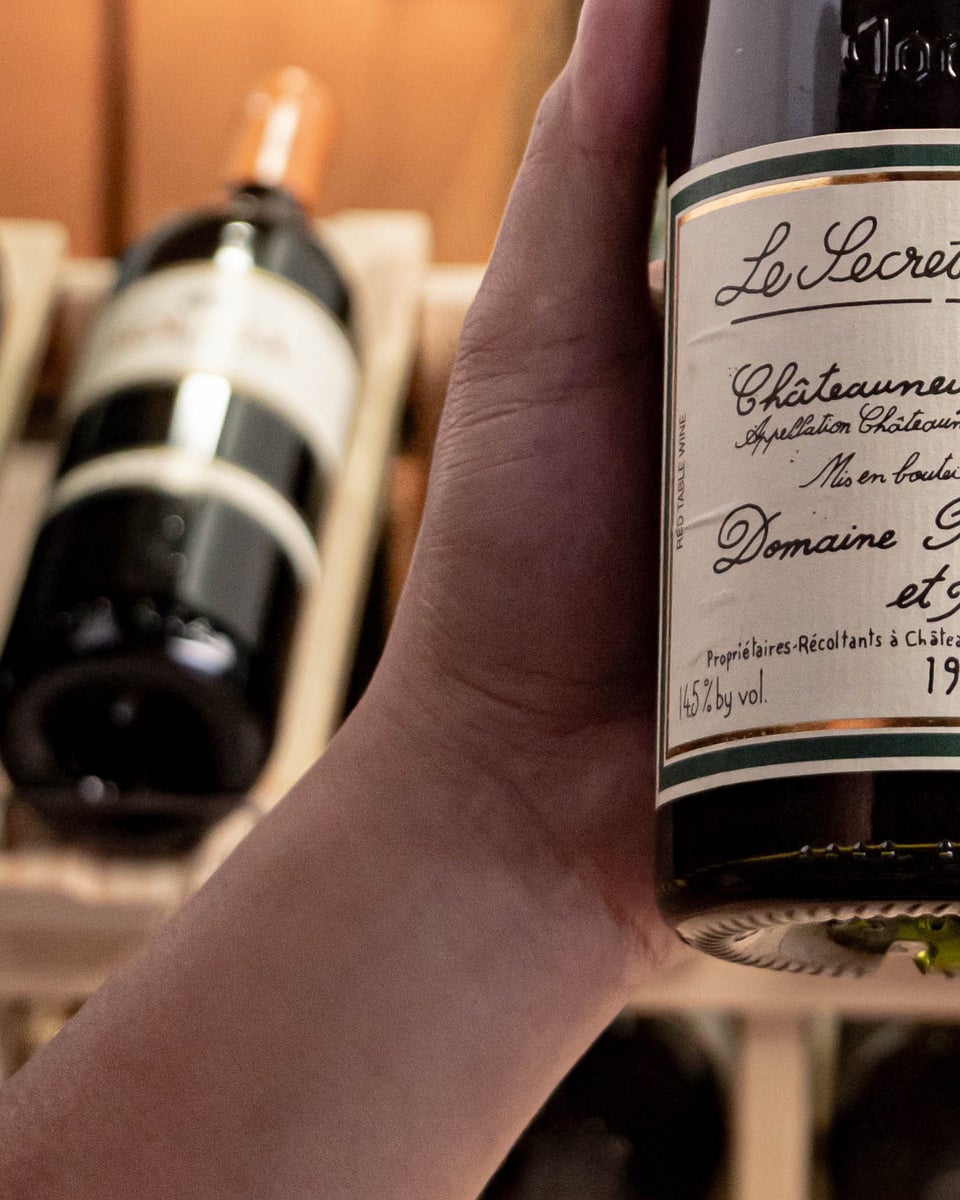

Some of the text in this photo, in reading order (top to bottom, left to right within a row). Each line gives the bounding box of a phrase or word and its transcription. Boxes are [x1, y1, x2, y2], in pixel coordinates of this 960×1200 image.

[715, 221, 792, 306] Le
[734, 413, 852, 457] Appellation
[676, 412, 686, 550] RED TABLE WINE
[799, 451, 856, 488] Mis
[857, 470, 886, 485] en
[713, 503, 898, 574] Domaine
[886, 564, 950, 609] et
[707, 627, 882, 671] Propriétaires-Récoltants
[890, 629, 899, 648] à
[716, 676, 733, 719] by
[738, 667, 768, 706] vol.
